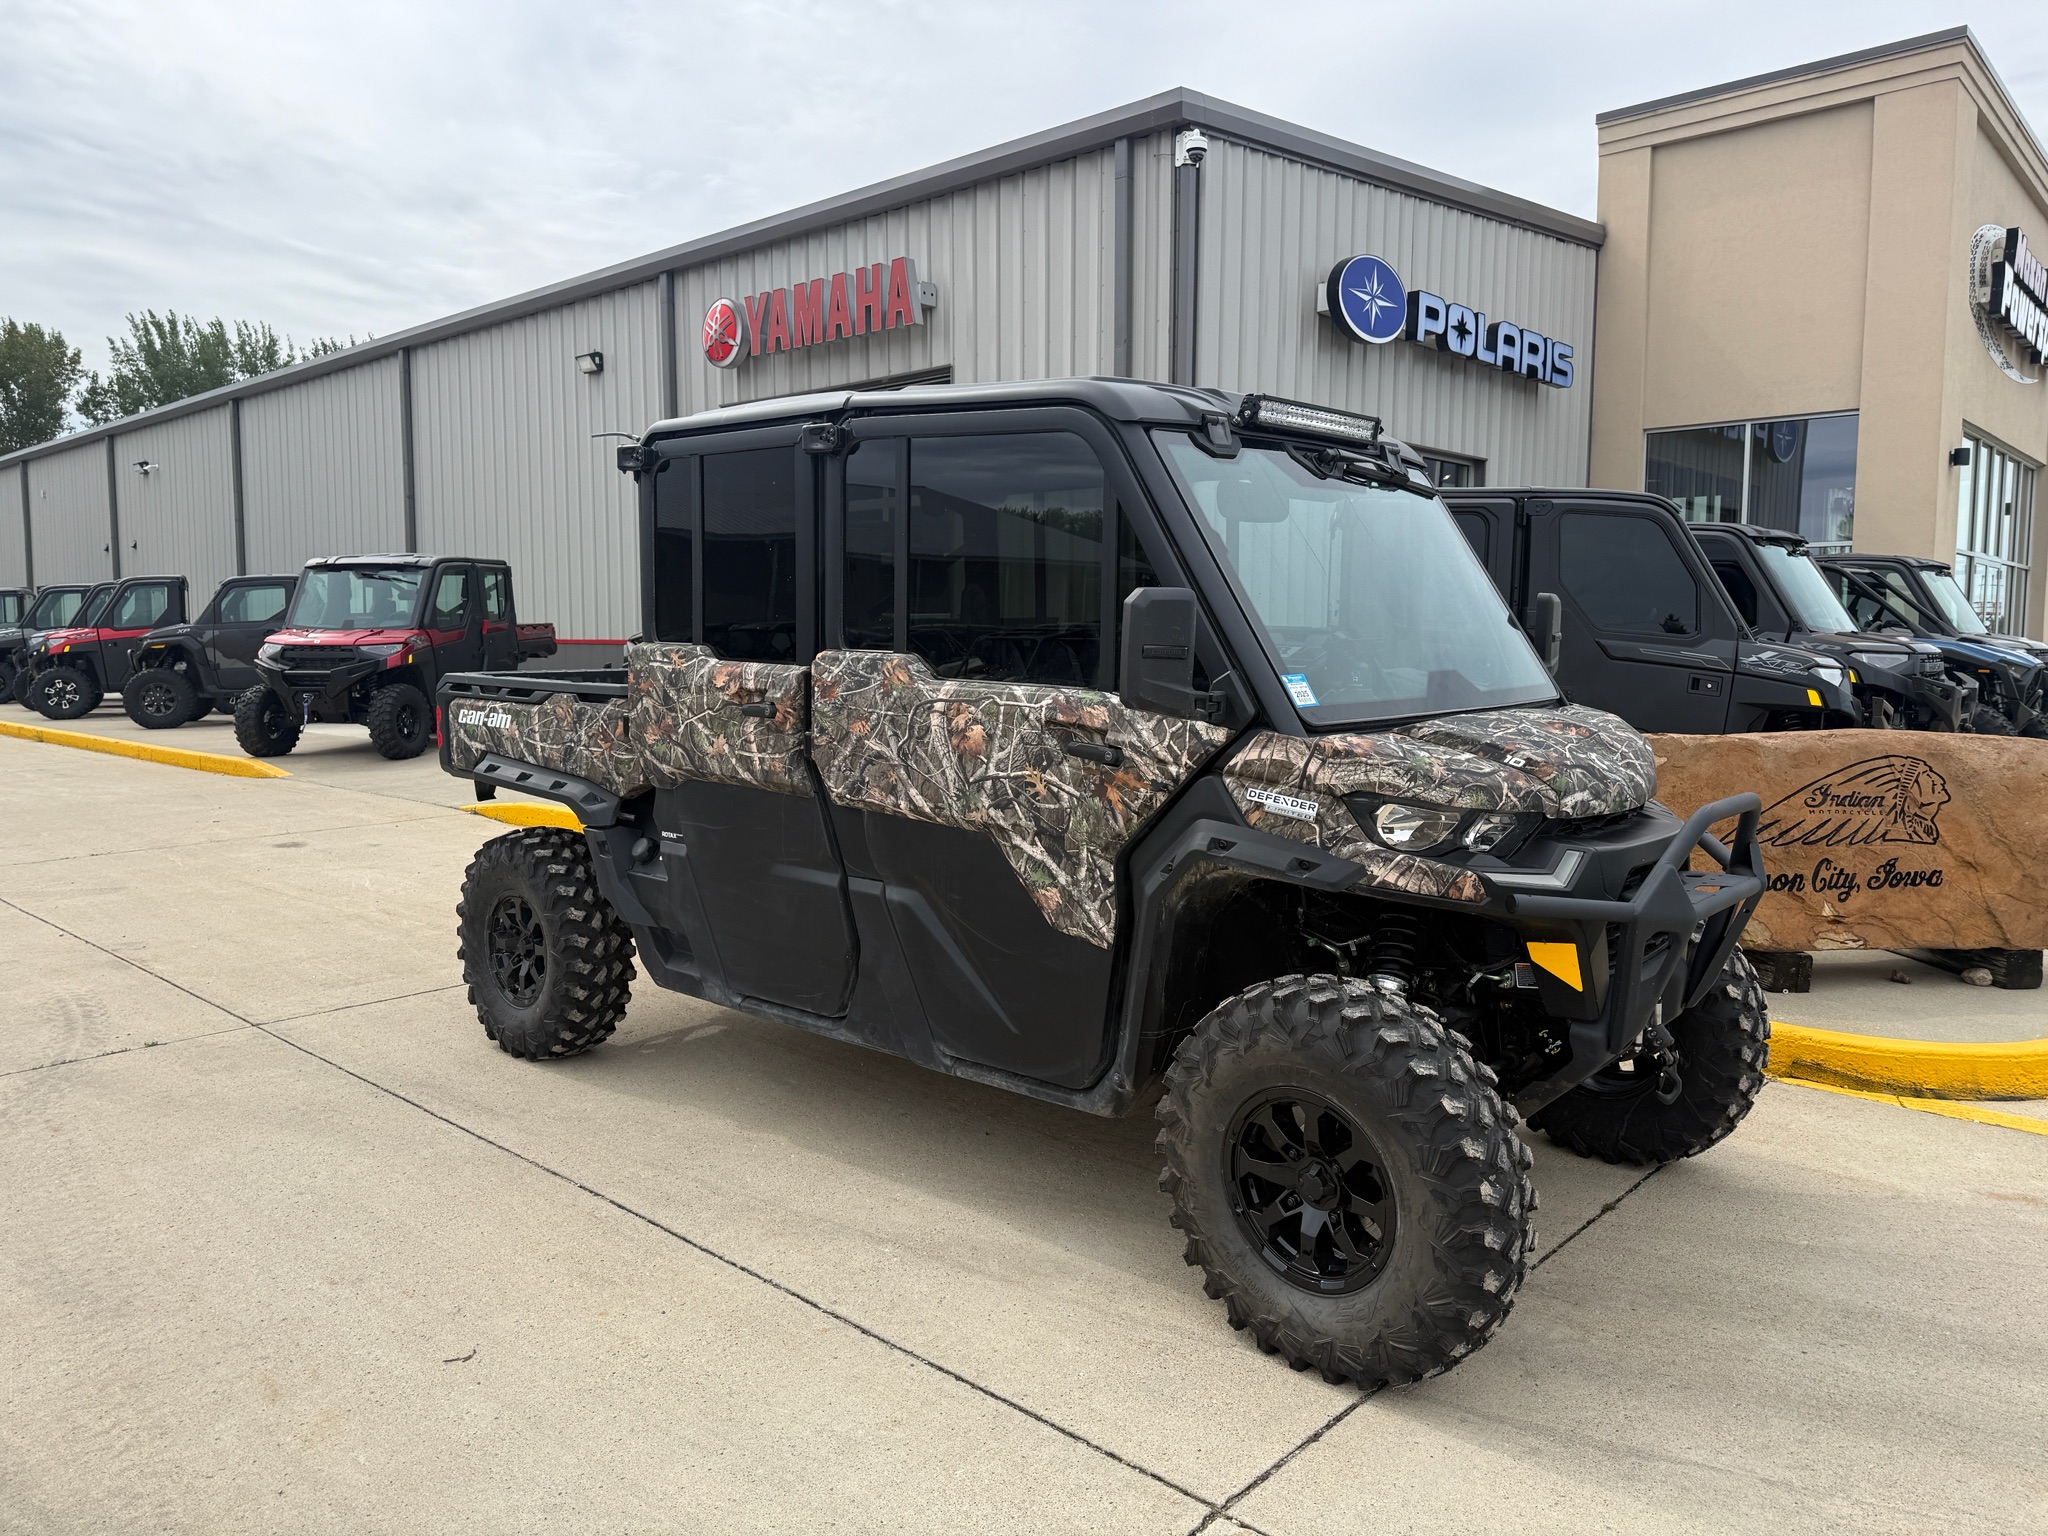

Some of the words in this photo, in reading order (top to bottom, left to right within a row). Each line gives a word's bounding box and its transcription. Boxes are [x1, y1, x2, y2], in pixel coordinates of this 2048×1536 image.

[744, 257, 917, 356] YAMAHA
[1412, 290, 1574, 388] POLARIS
[1800, 640, 1842, 651] XP
[458, 709, 511, 729] can-am
[1248, 789, 1317, 812] DEFENDER
[1804, 784, 1886, 808] Indian
[1811, 857, 1860, 903] City,
[1867, 857, 1943, 891] Iowa
